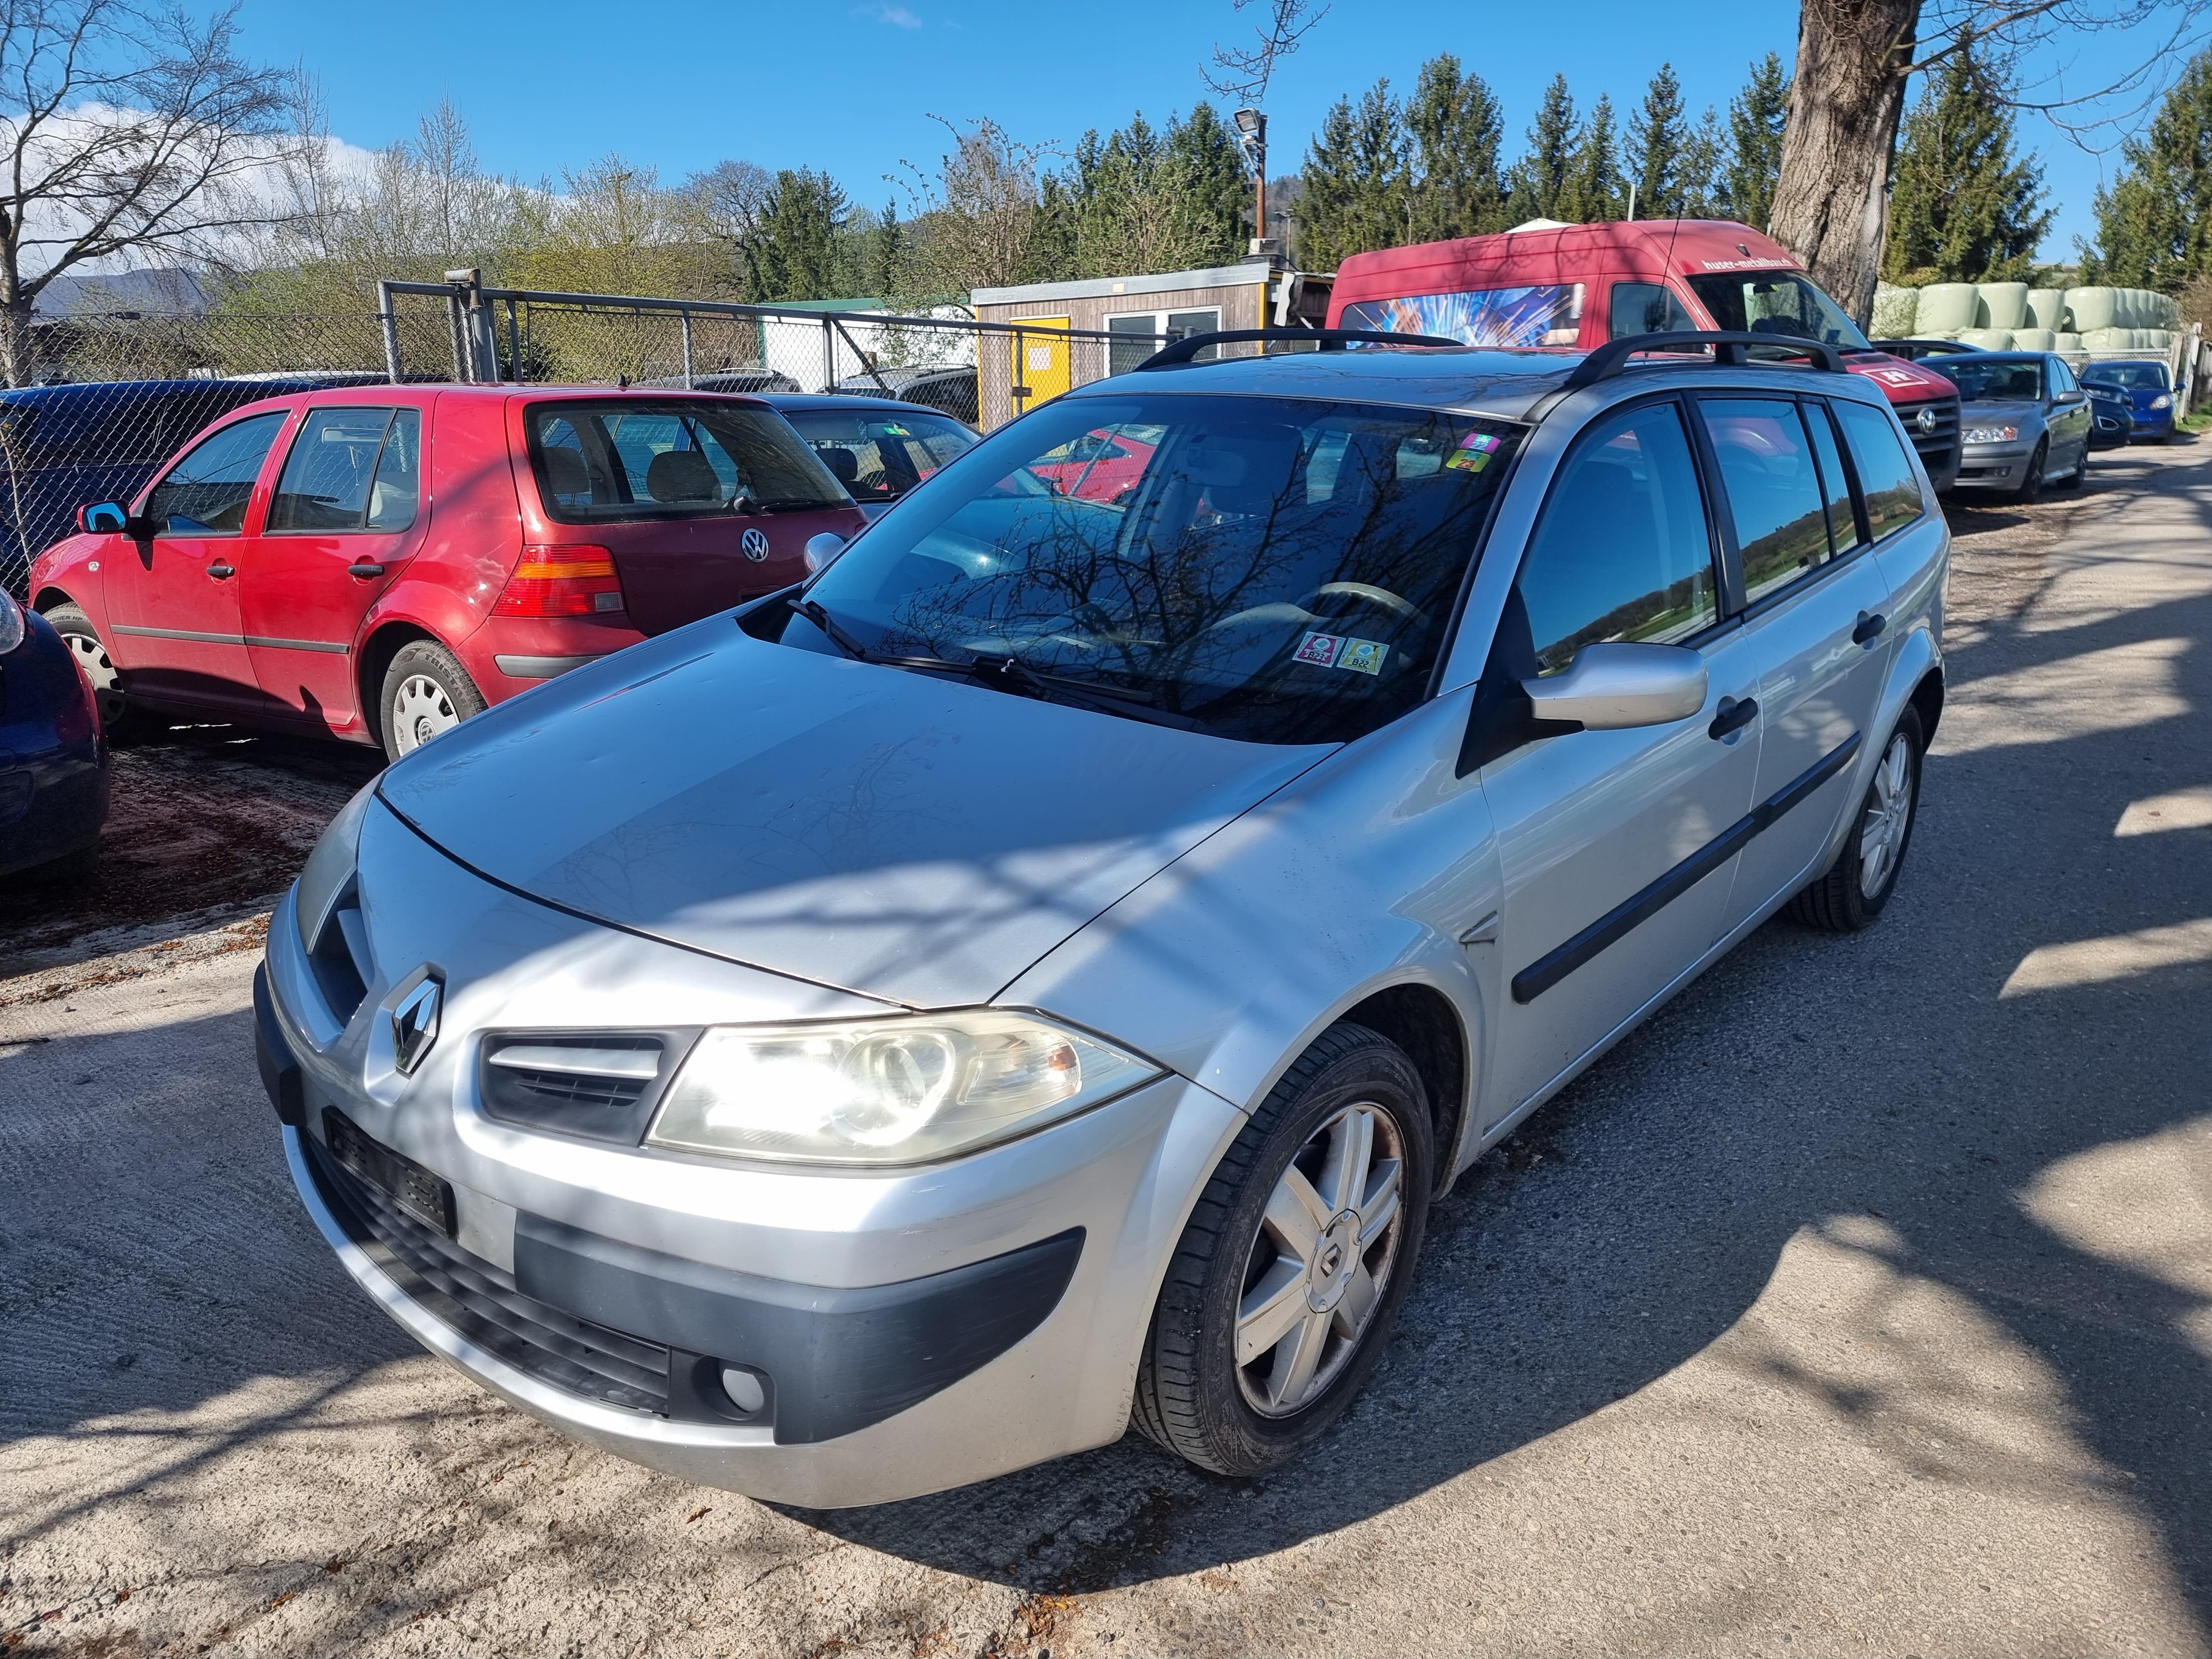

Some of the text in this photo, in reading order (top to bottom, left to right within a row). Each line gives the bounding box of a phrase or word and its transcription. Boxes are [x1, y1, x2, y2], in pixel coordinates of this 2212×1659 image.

[1701, 257, 1794, 270] huser-metallbau.ch
[1469, 441, 1488, 450] 22
[1457, 458, 1475, 468] 23
[1307, 651, 1324, 660] B23
[1352, 659, 1369, 668] B22
[425, 653, 468, 707] TRISTAR
